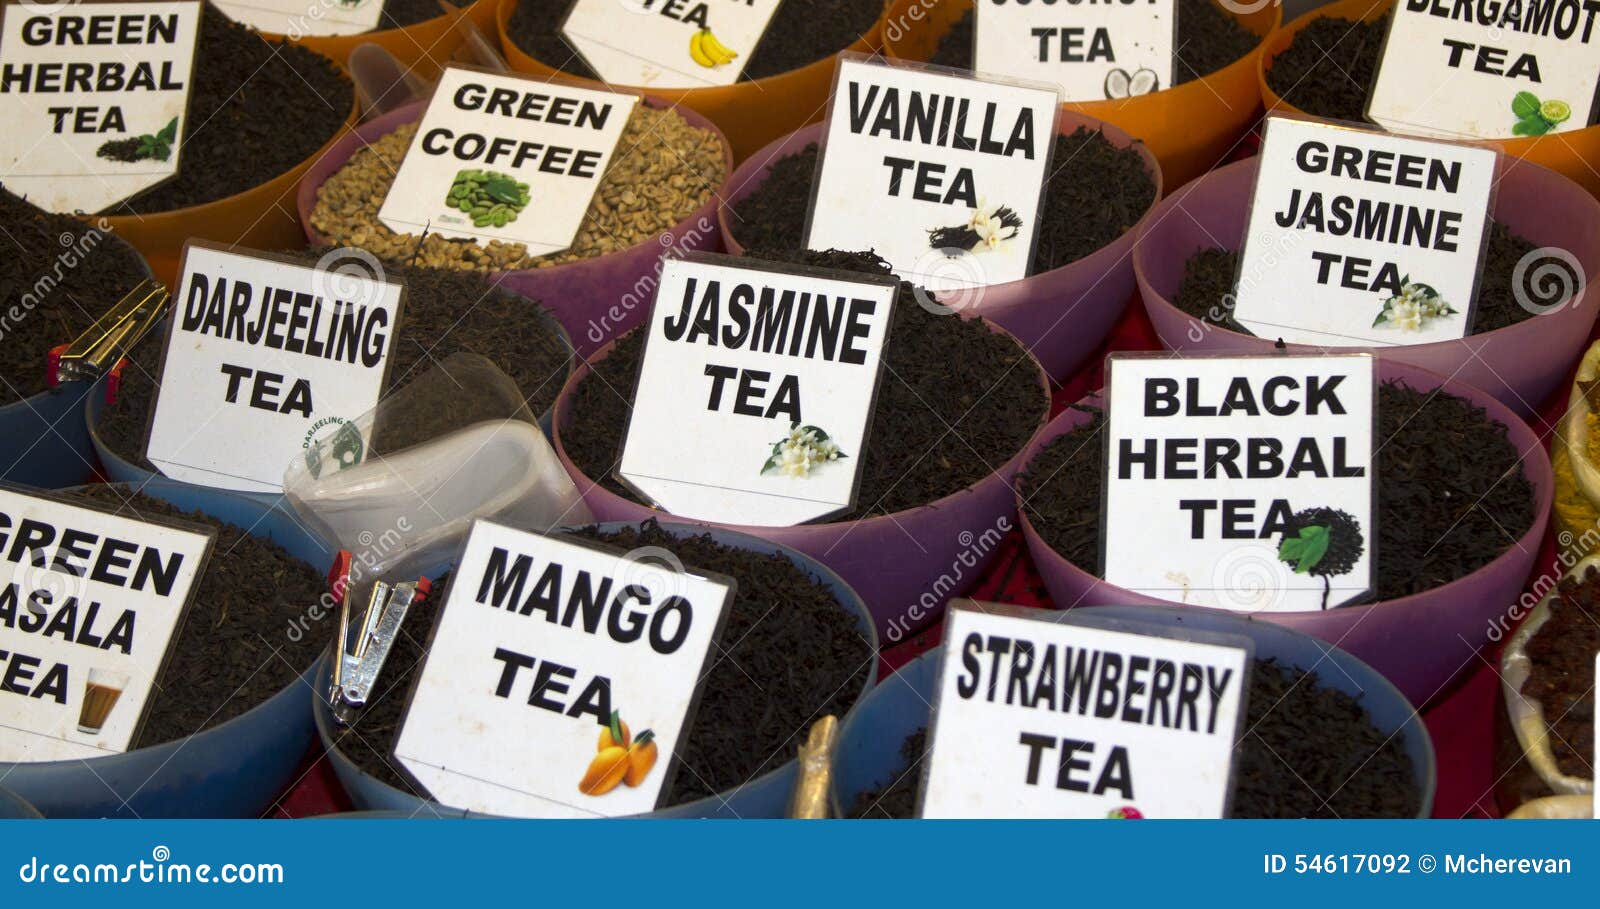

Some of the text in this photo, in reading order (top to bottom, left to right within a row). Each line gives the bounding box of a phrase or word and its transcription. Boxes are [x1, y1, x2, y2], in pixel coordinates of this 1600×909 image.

[21, 14, 179, 46] GREEN
[1031, 27, 1115, 62] TEA
[1407, 0, 1600, 44] RGAMOT
[0, 62, 184, 93] HERBAL
[1442, 38, 1542, 83] TEA
[47, 106, 126, 134] TEA
[453, 83, 612, 130] GREEN
[849, 81, 1035, 161] VANILLA
[421, 128, 603, 179] COFFEE
[1295, 141, 1462, 195] GREEN
[883, 156, 979, 208] TEA
[1275, 189, 1463, 253] JASMINE
[1311, 251, 1402, 296] TEA
[181, 271, 387, 369] DARJEELING
[663, 277, 877, 365] JASMINE
[220, 363, 314, 419] TEA
[704, 363, 801, 422] TEA
[1144, 375, 1347, 417] BLACK
[302, 416, 344, 449] DARJEELING
[1118, 436, 1365, 480] HERBAL
[1179, 499, 1300, 540] TEA
[475, 546, 694, 655] MANGO
[493, 647, 613, 725] TEA
[956, 632, 1233, 735] STRAWBERRY
[1018, 732, 1135, 800] TEA
